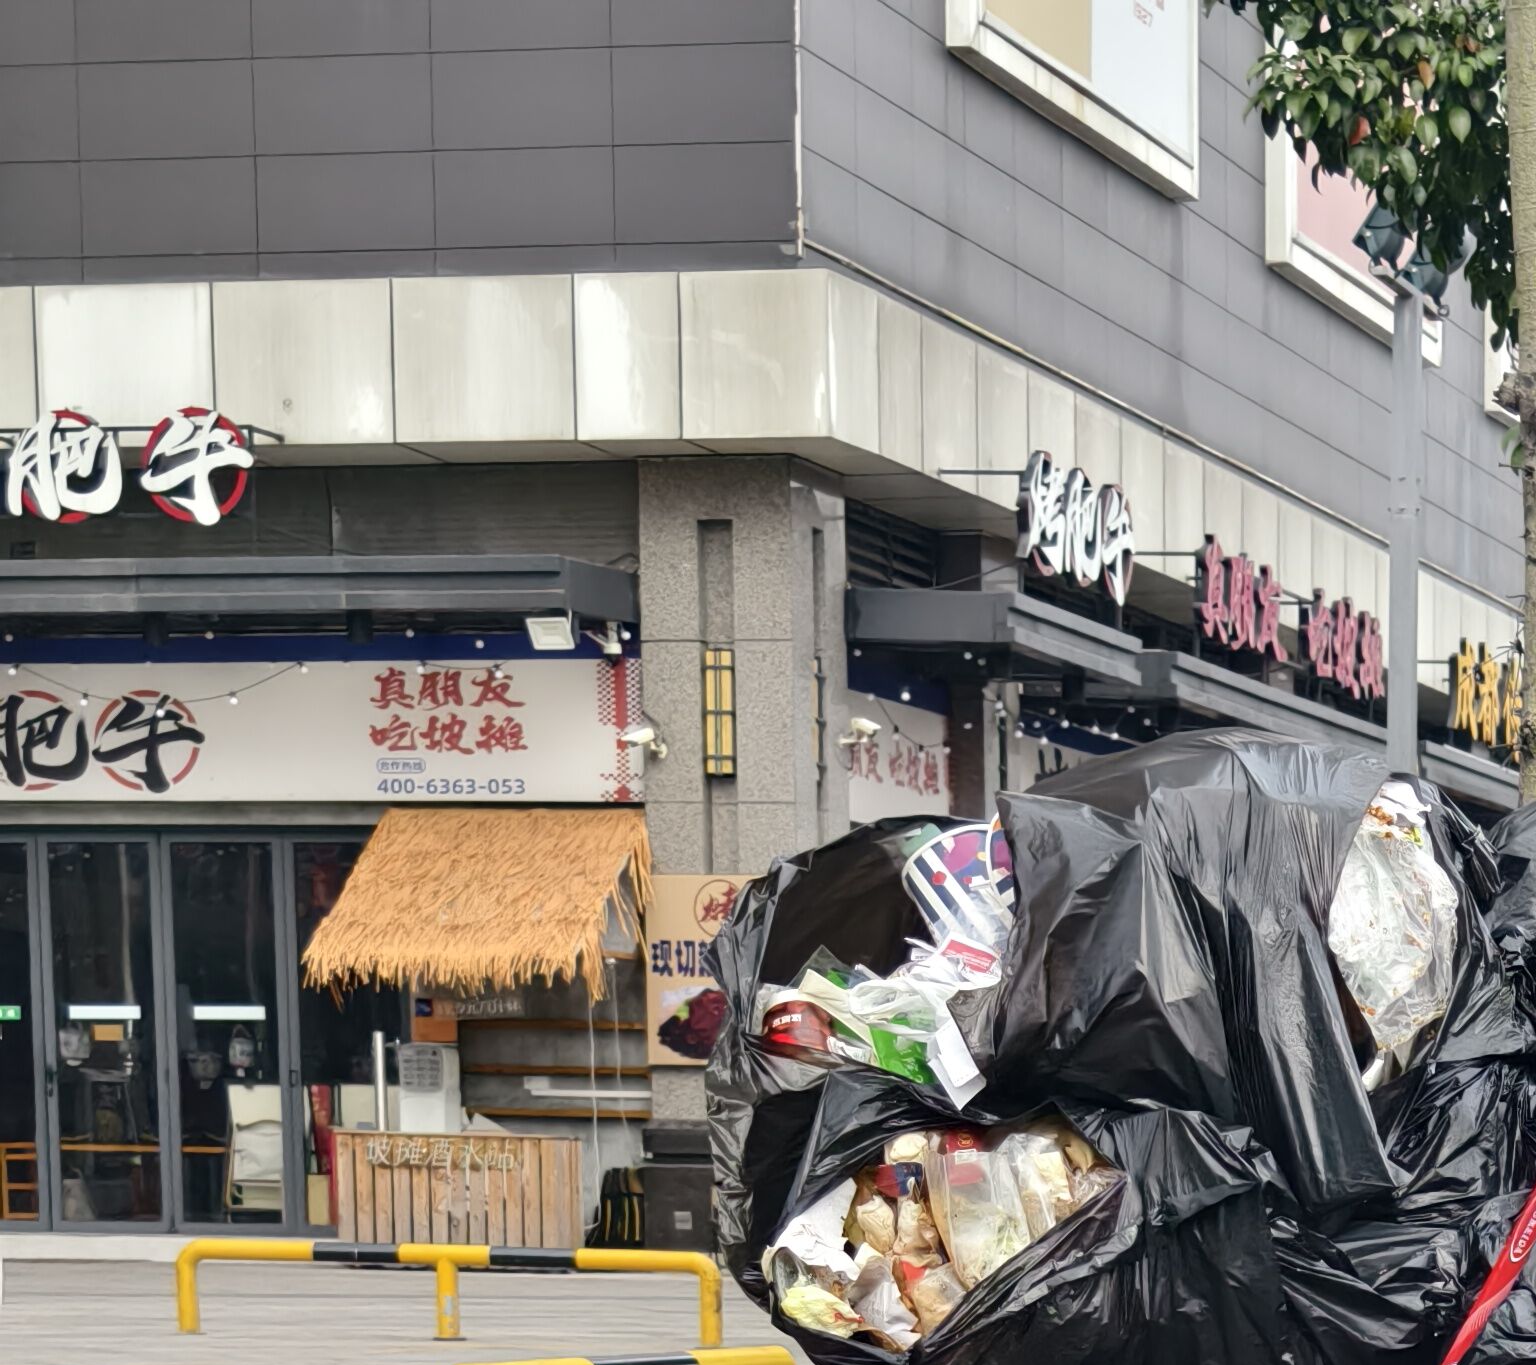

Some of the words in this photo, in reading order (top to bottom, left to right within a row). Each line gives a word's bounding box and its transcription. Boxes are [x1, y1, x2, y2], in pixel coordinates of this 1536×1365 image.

[7, 410, 254, 526] 肥牛
[370, 667, 526, 711] 真朋友
[377, 778, 526, 794] 400-6363-053
